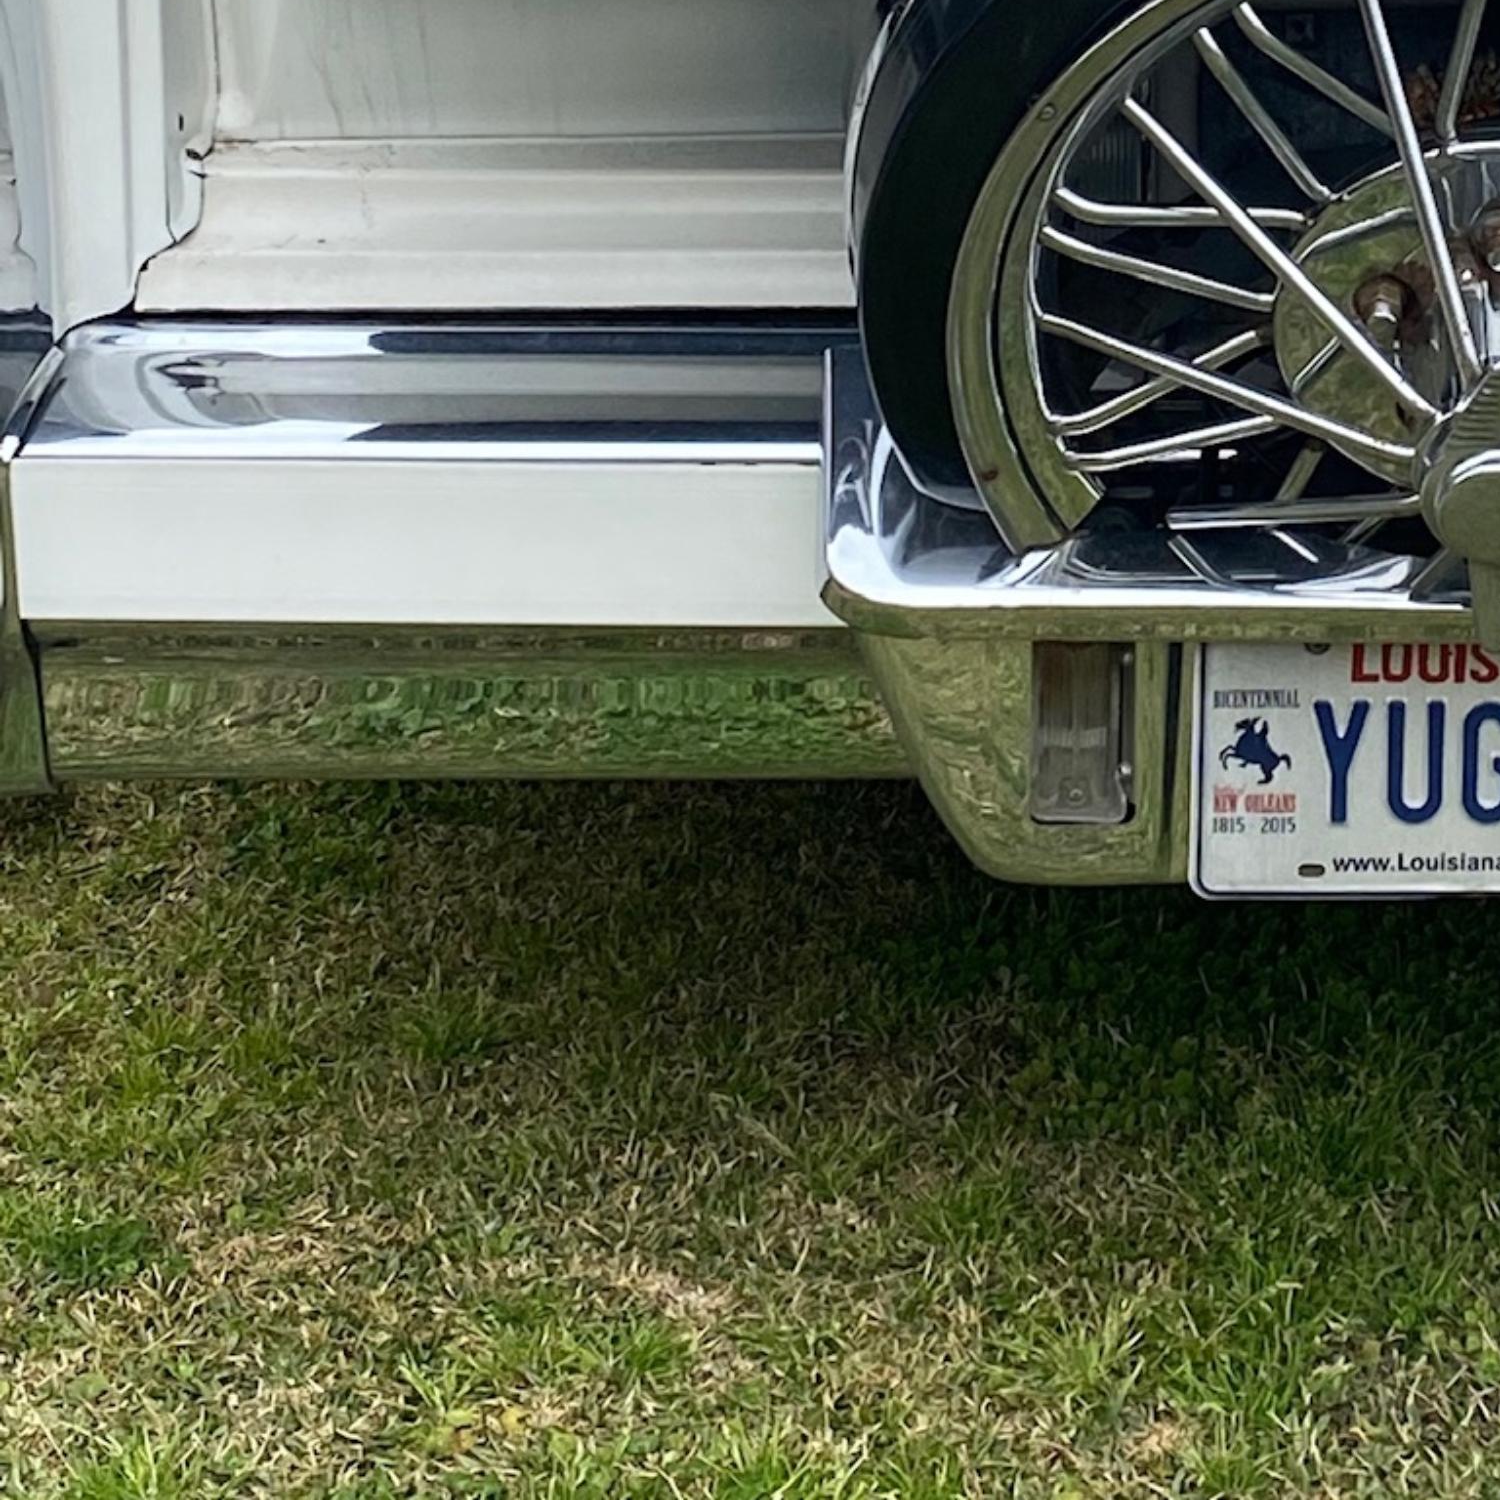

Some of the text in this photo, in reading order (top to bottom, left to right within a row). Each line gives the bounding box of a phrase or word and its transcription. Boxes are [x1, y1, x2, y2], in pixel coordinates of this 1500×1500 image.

[1213, 689, 1300, 708] BICENTENNIAL
[1212, 816, 1297, 834] 1815 2015
